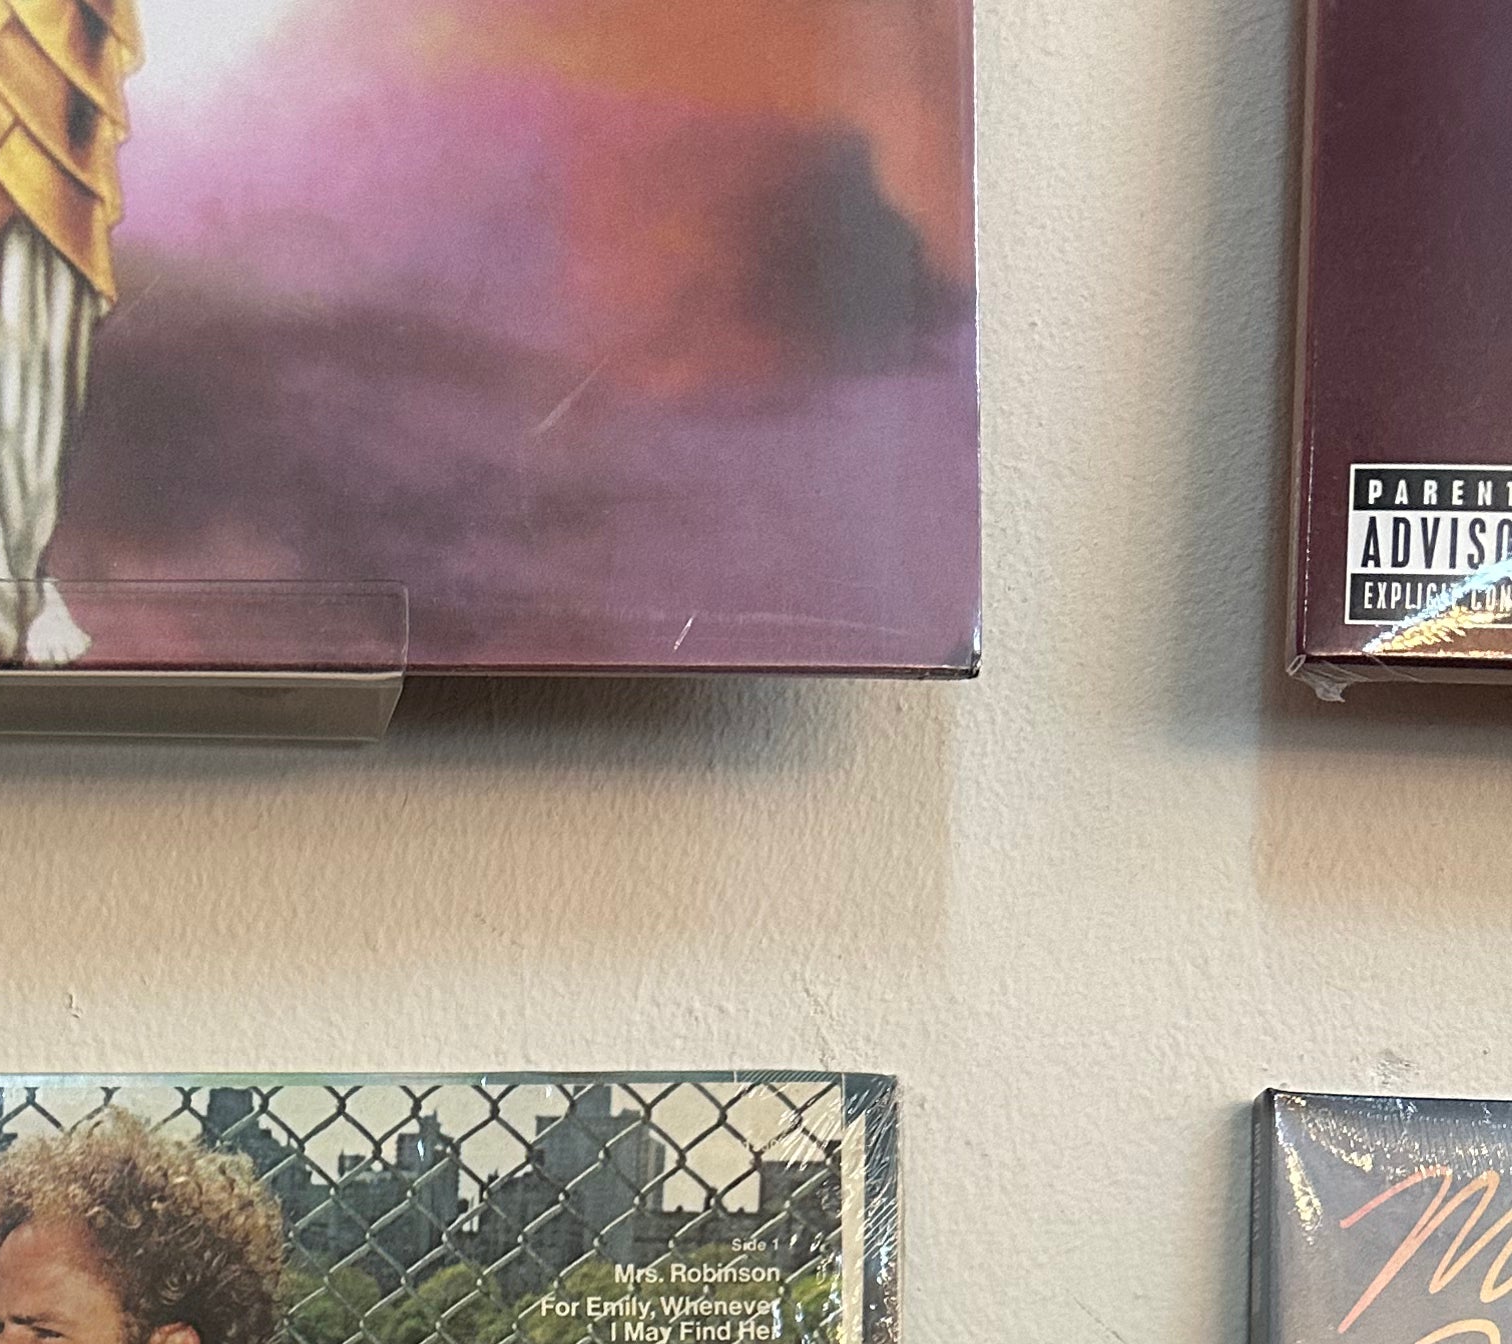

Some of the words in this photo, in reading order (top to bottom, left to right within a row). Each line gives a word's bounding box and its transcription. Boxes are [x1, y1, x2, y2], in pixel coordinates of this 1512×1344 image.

[731, 1237, 767, 1252] Side
[771, 1238, 779, 1251] 1
[614, 1263, 664, 1283] Mrs.
[670, 1263, 780, 1283] Robinson
[540, 1296, 580, 1317] For
[587, 1296, 656, 1320] Emily,
[660, 1296, 780, 1317] Whenever
[610, 1322, 616, 1342] I
[624, 1321, 673, 1344] May
[679, 1321, 731, 1341] Find
[739, 1321, 779, 1341] Her
